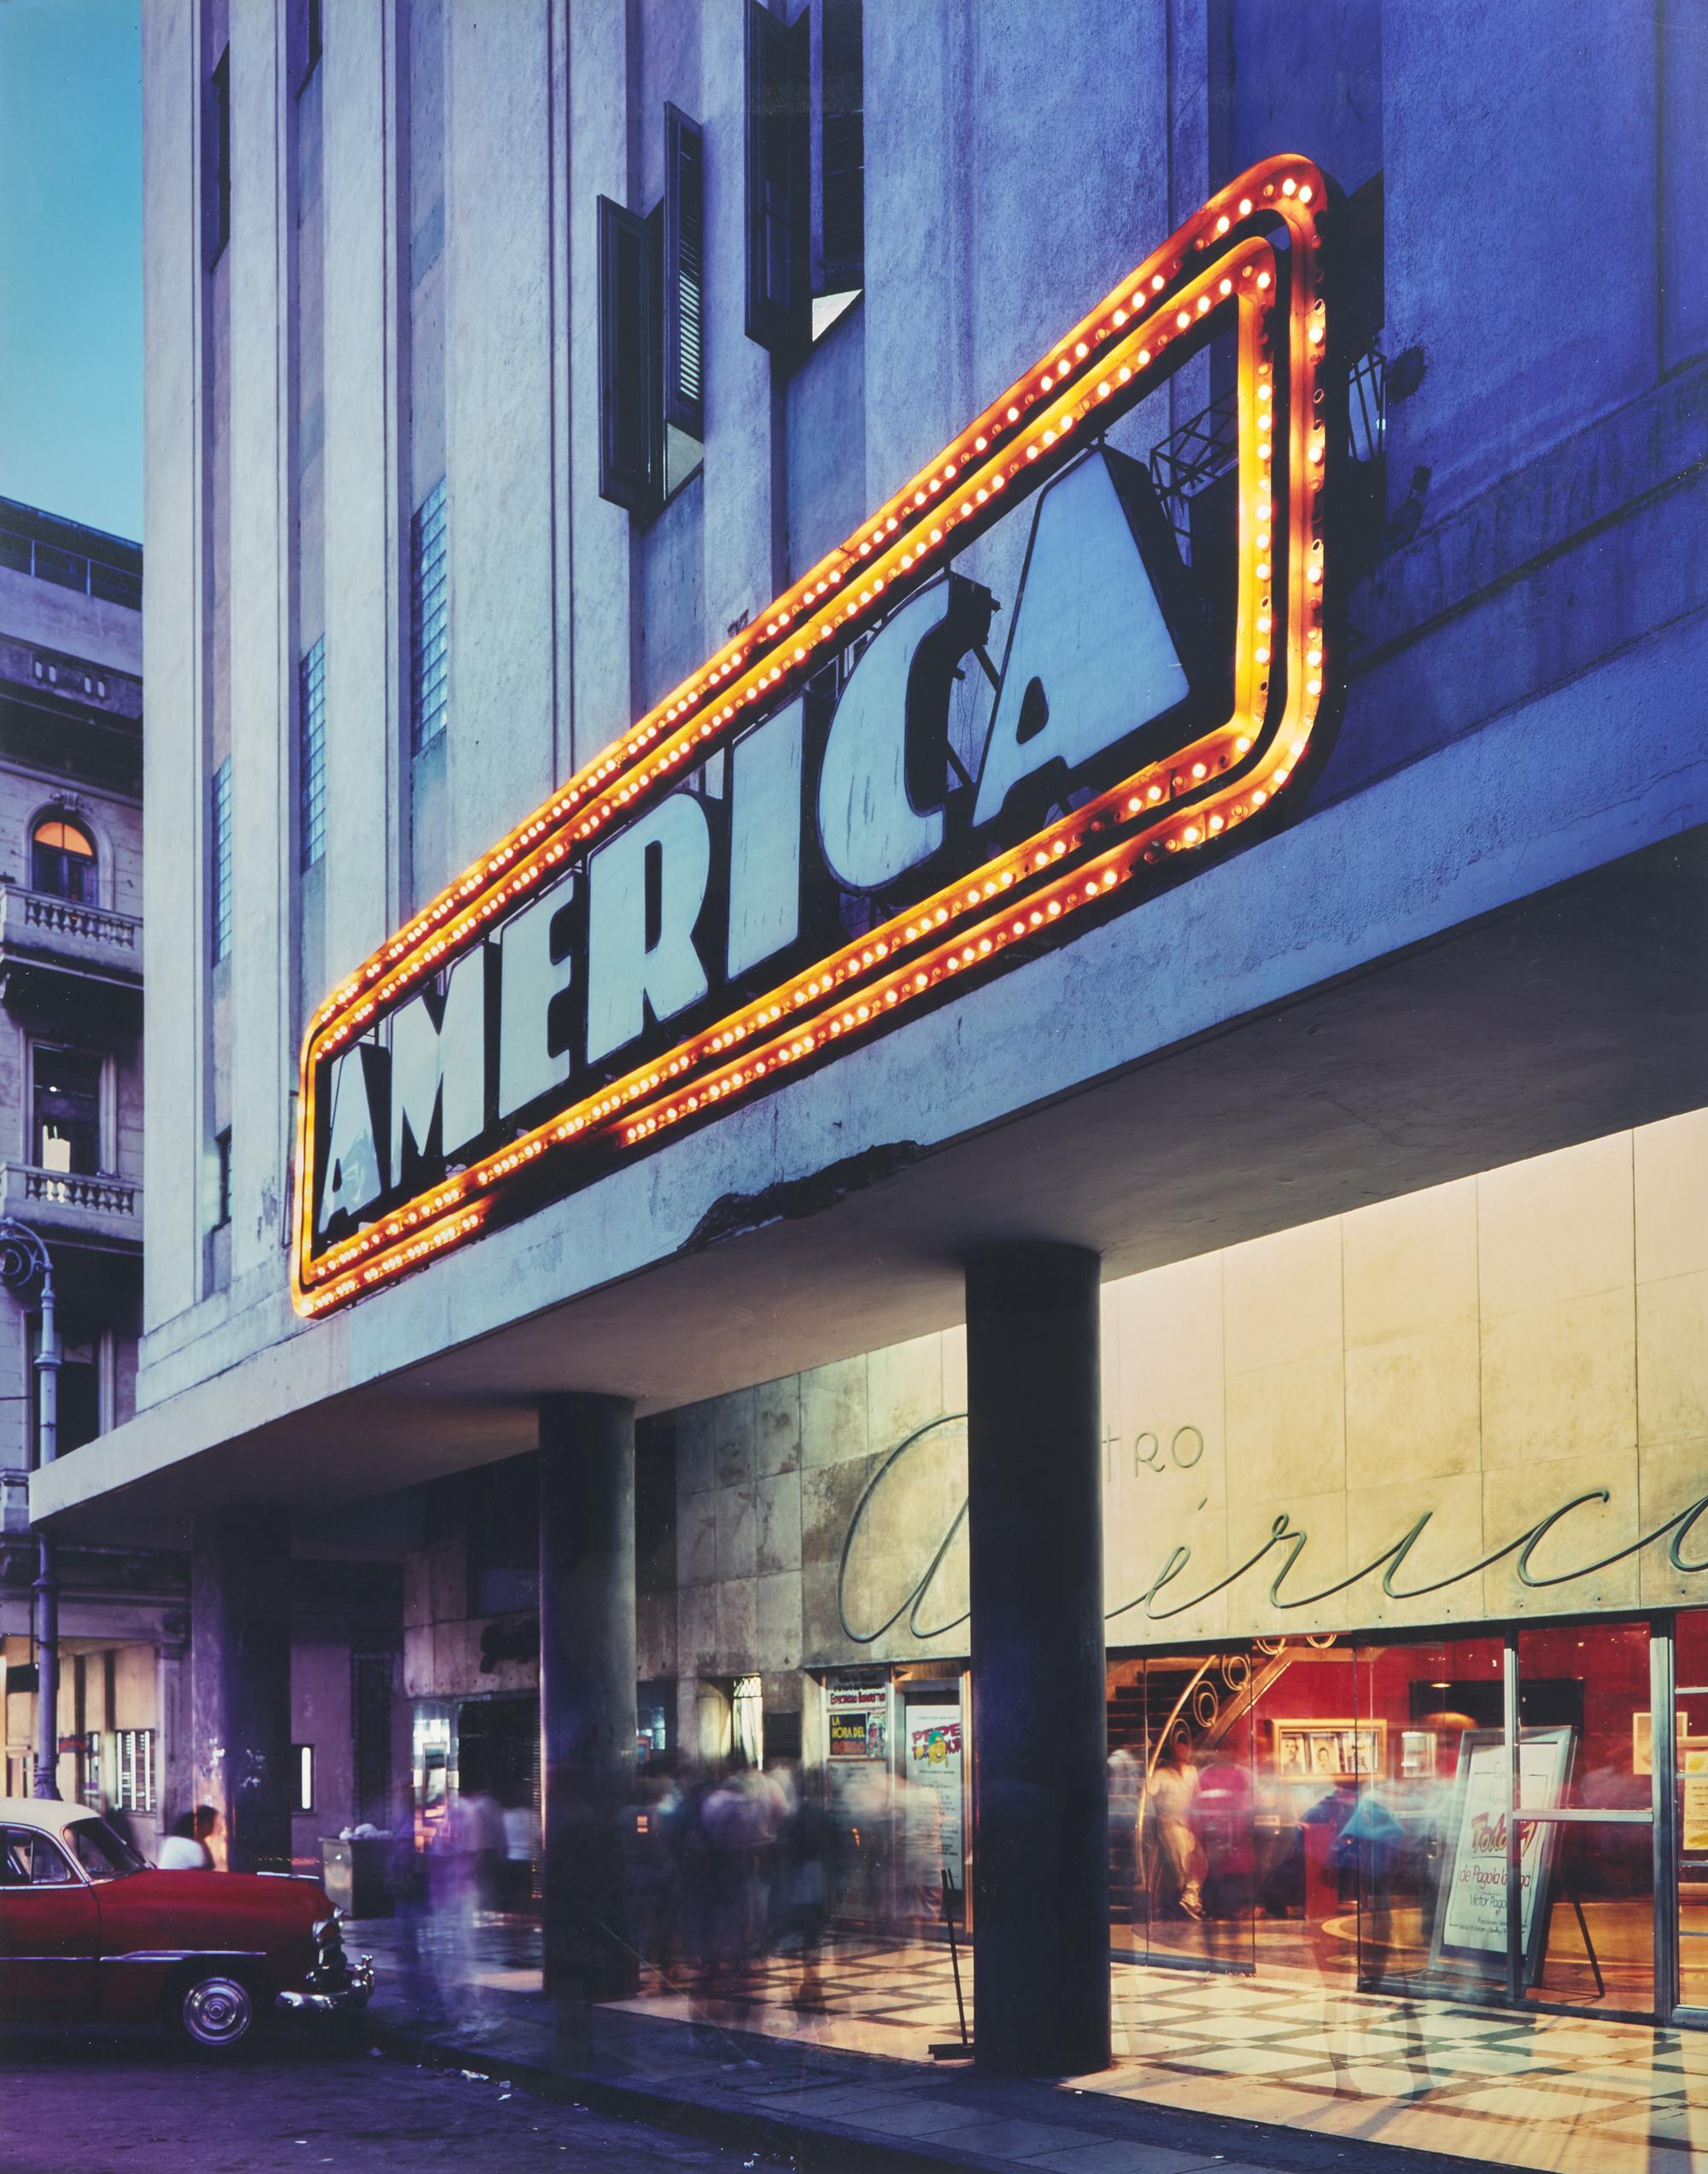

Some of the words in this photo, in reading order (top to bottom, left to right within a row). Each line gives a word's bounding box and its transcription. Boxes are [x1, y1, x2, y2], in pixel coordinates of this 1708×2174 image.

[319, 448, 1190, 1233] AMERICA
[832, 1715, 840, 1726] LA
[853, 1726, 865, 1737] DEL
